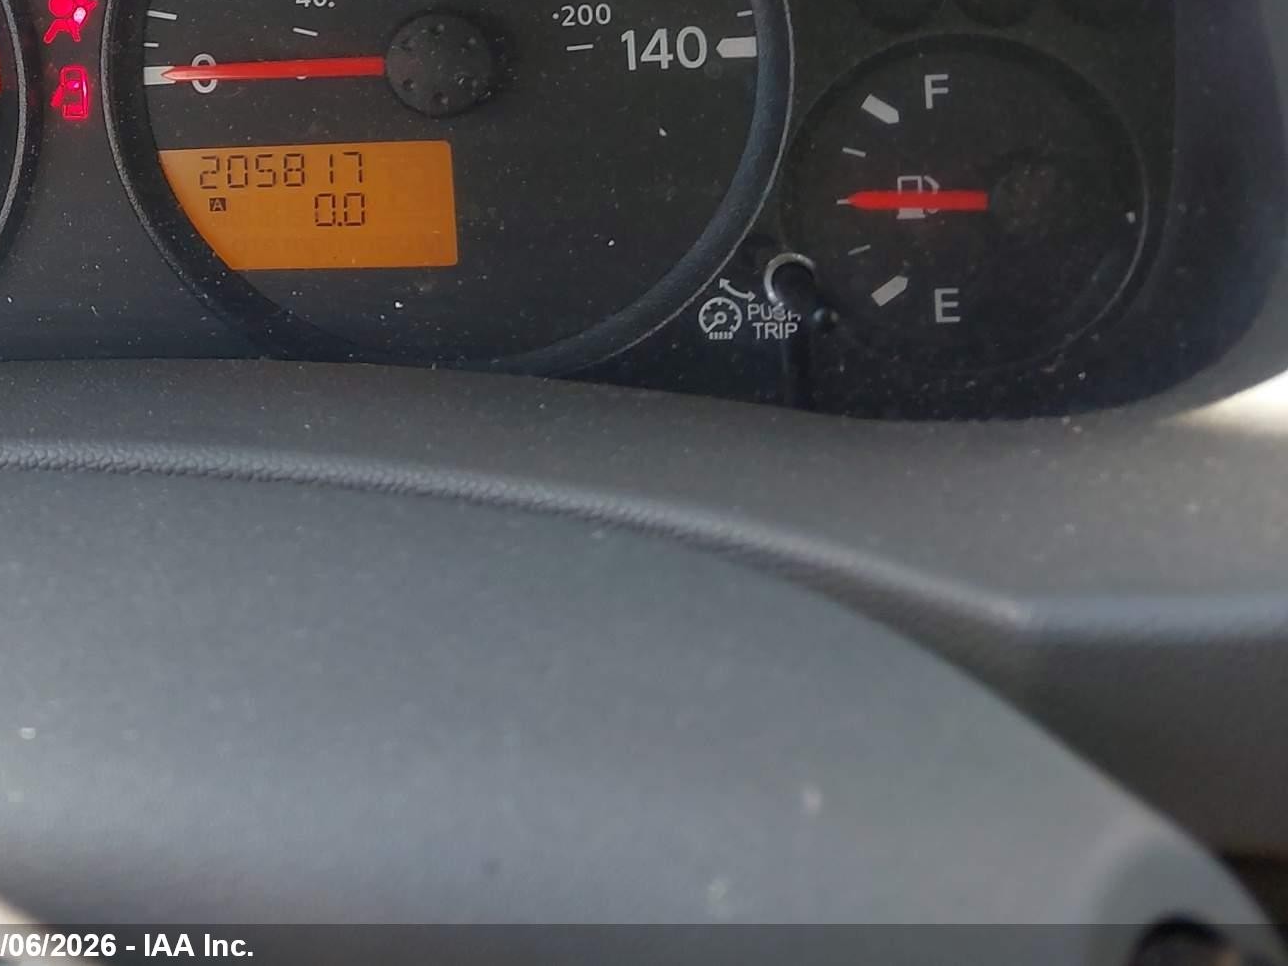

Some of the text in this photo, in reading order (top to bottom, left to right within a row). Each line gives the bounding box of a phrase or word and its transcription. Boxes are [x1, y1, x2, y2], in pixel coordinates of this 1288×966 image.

[561, 3, 611, 27] 200
[621, 26, 708, 71] 140
[191, 53, 218, 94] 0
[924, 73, 949, 110] F
[198, 151, 364, 190] 205817
[314, 193, 365, 227] 0.0
[934, 288, 961, 323] E
[752, 321, 798, 340] TRIP
